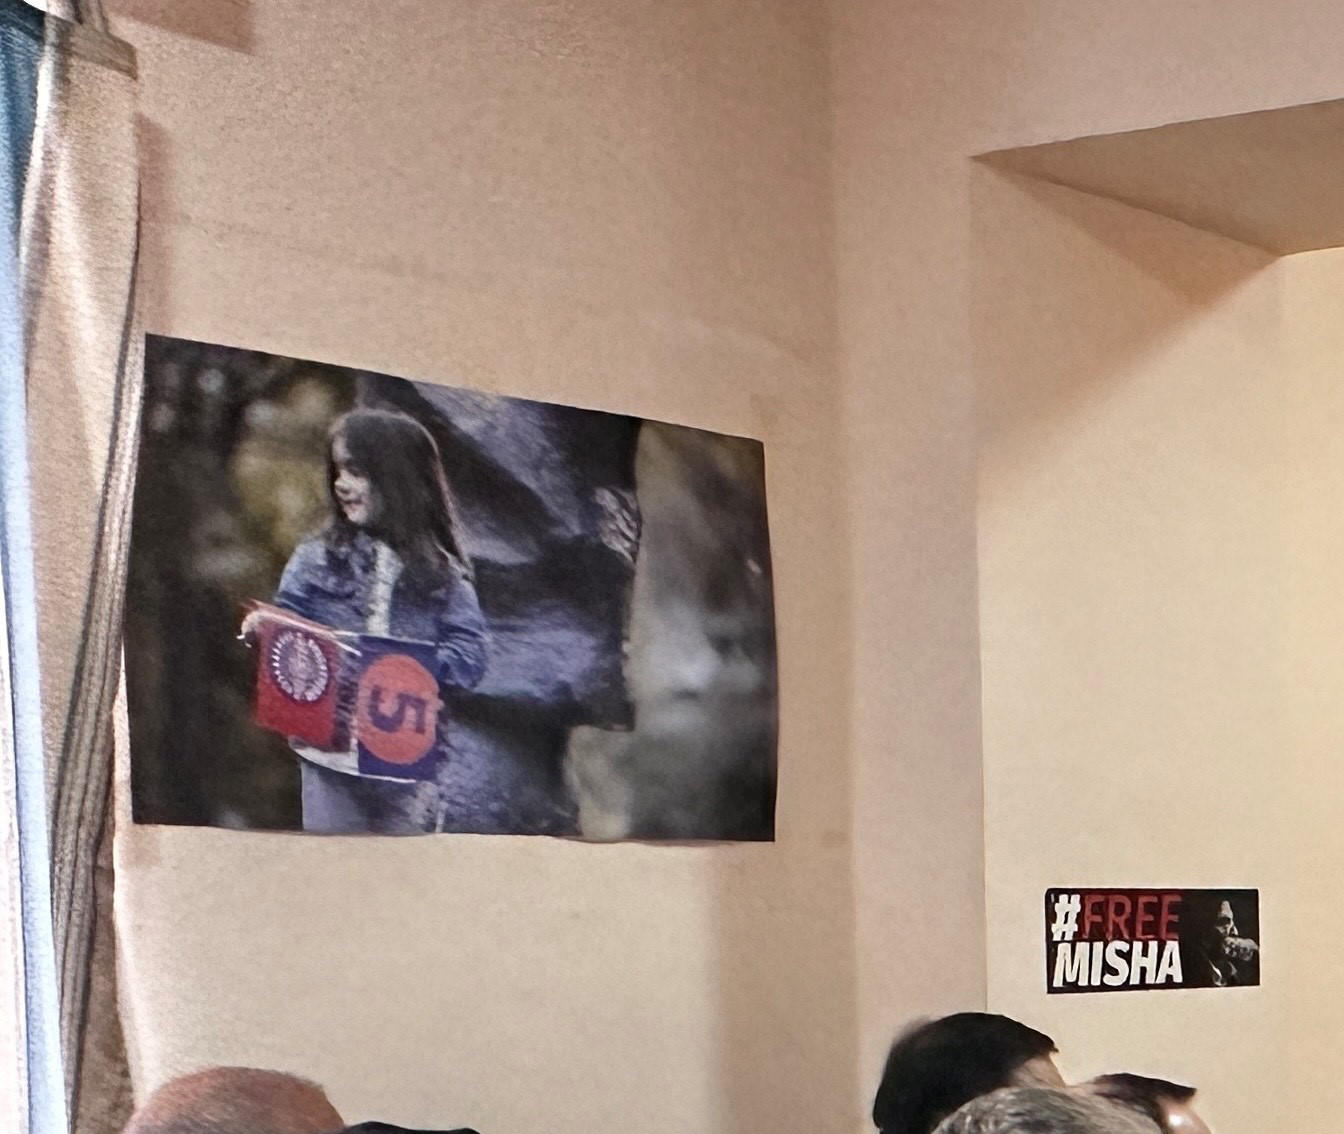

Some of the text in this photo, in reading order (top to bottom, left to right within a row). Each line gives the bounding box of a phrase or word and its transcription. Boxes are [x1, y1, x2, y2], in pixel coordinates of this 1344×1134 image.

[369, 686, 426, 734] 5
[1051, 894, 1182, 941] #FREE
[1053, 941, 1183, 987] MISHA
